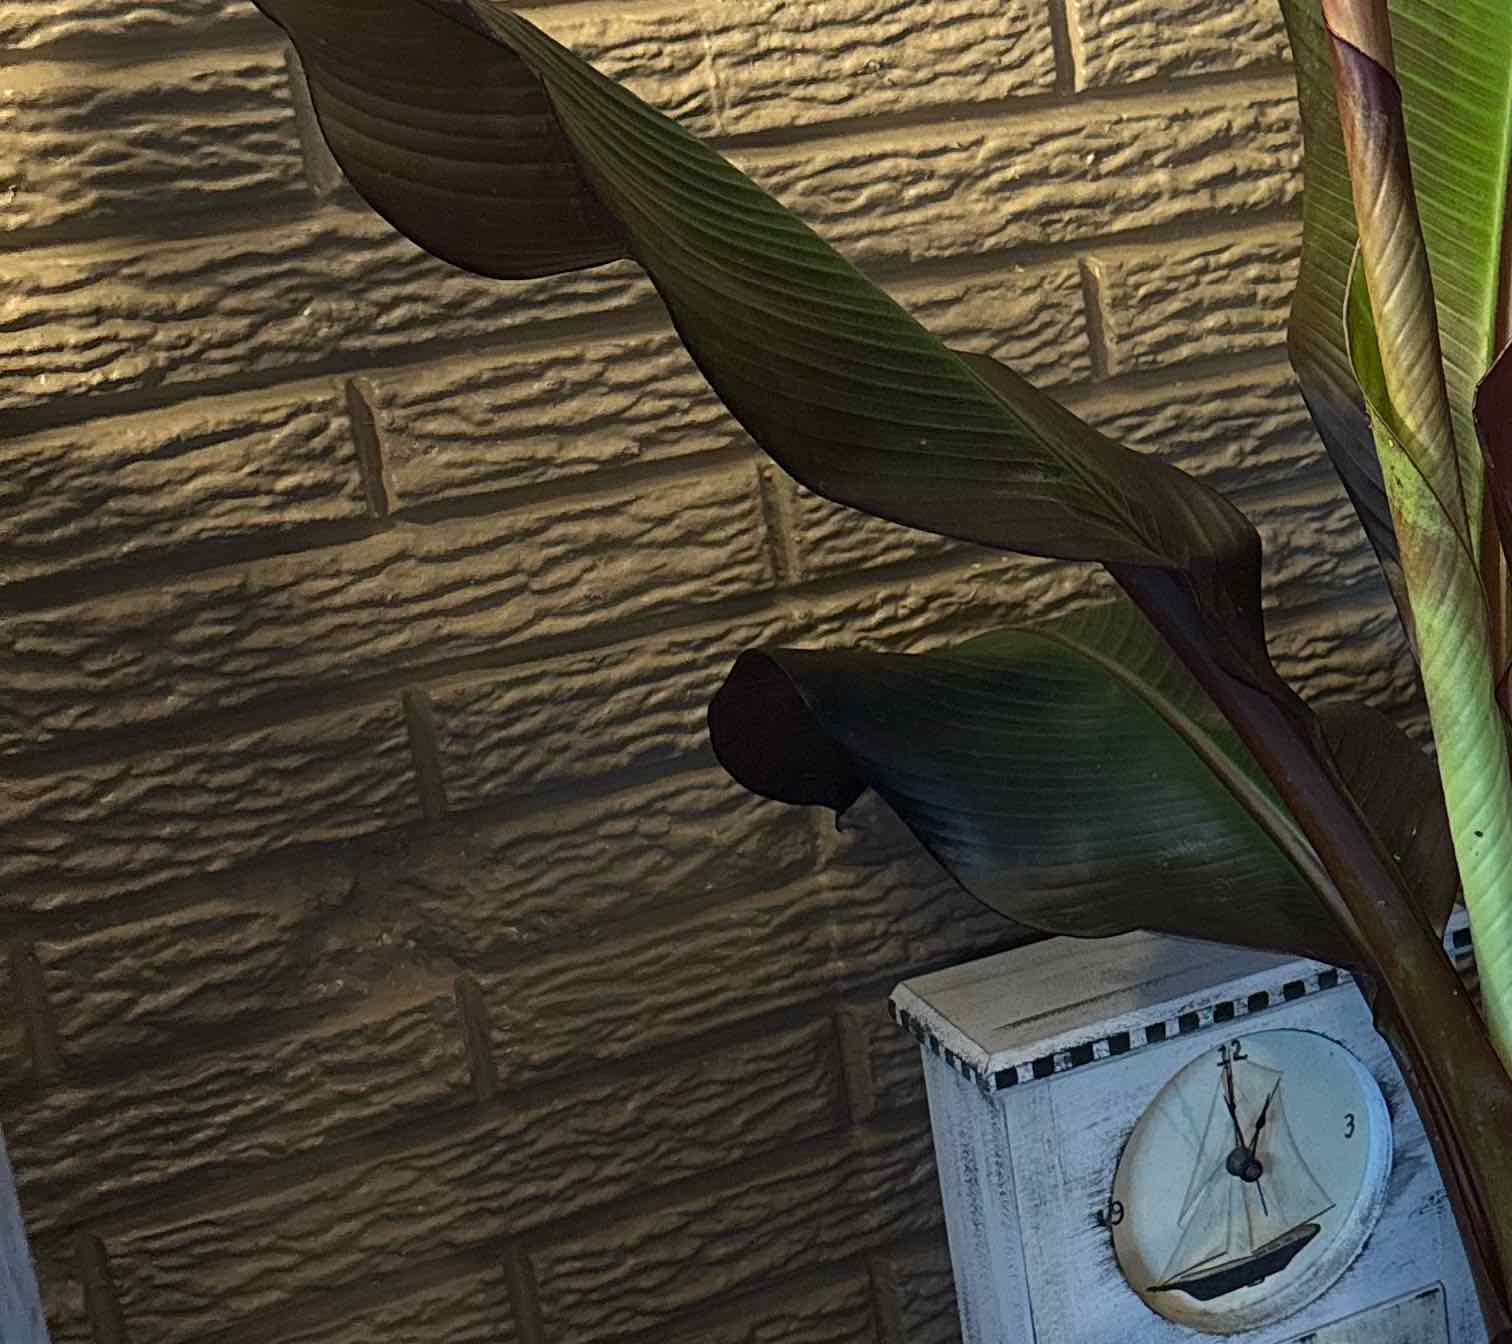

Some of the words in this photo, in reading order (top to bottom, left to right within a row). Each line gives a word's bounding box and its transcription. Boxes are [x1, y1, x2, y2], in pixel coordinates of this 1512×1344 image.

[1216, 1039, 1249, 1068] 12
[1343, 1113, 1356, 1139] 3
[1110, 1200, 1125, 1226] 9
